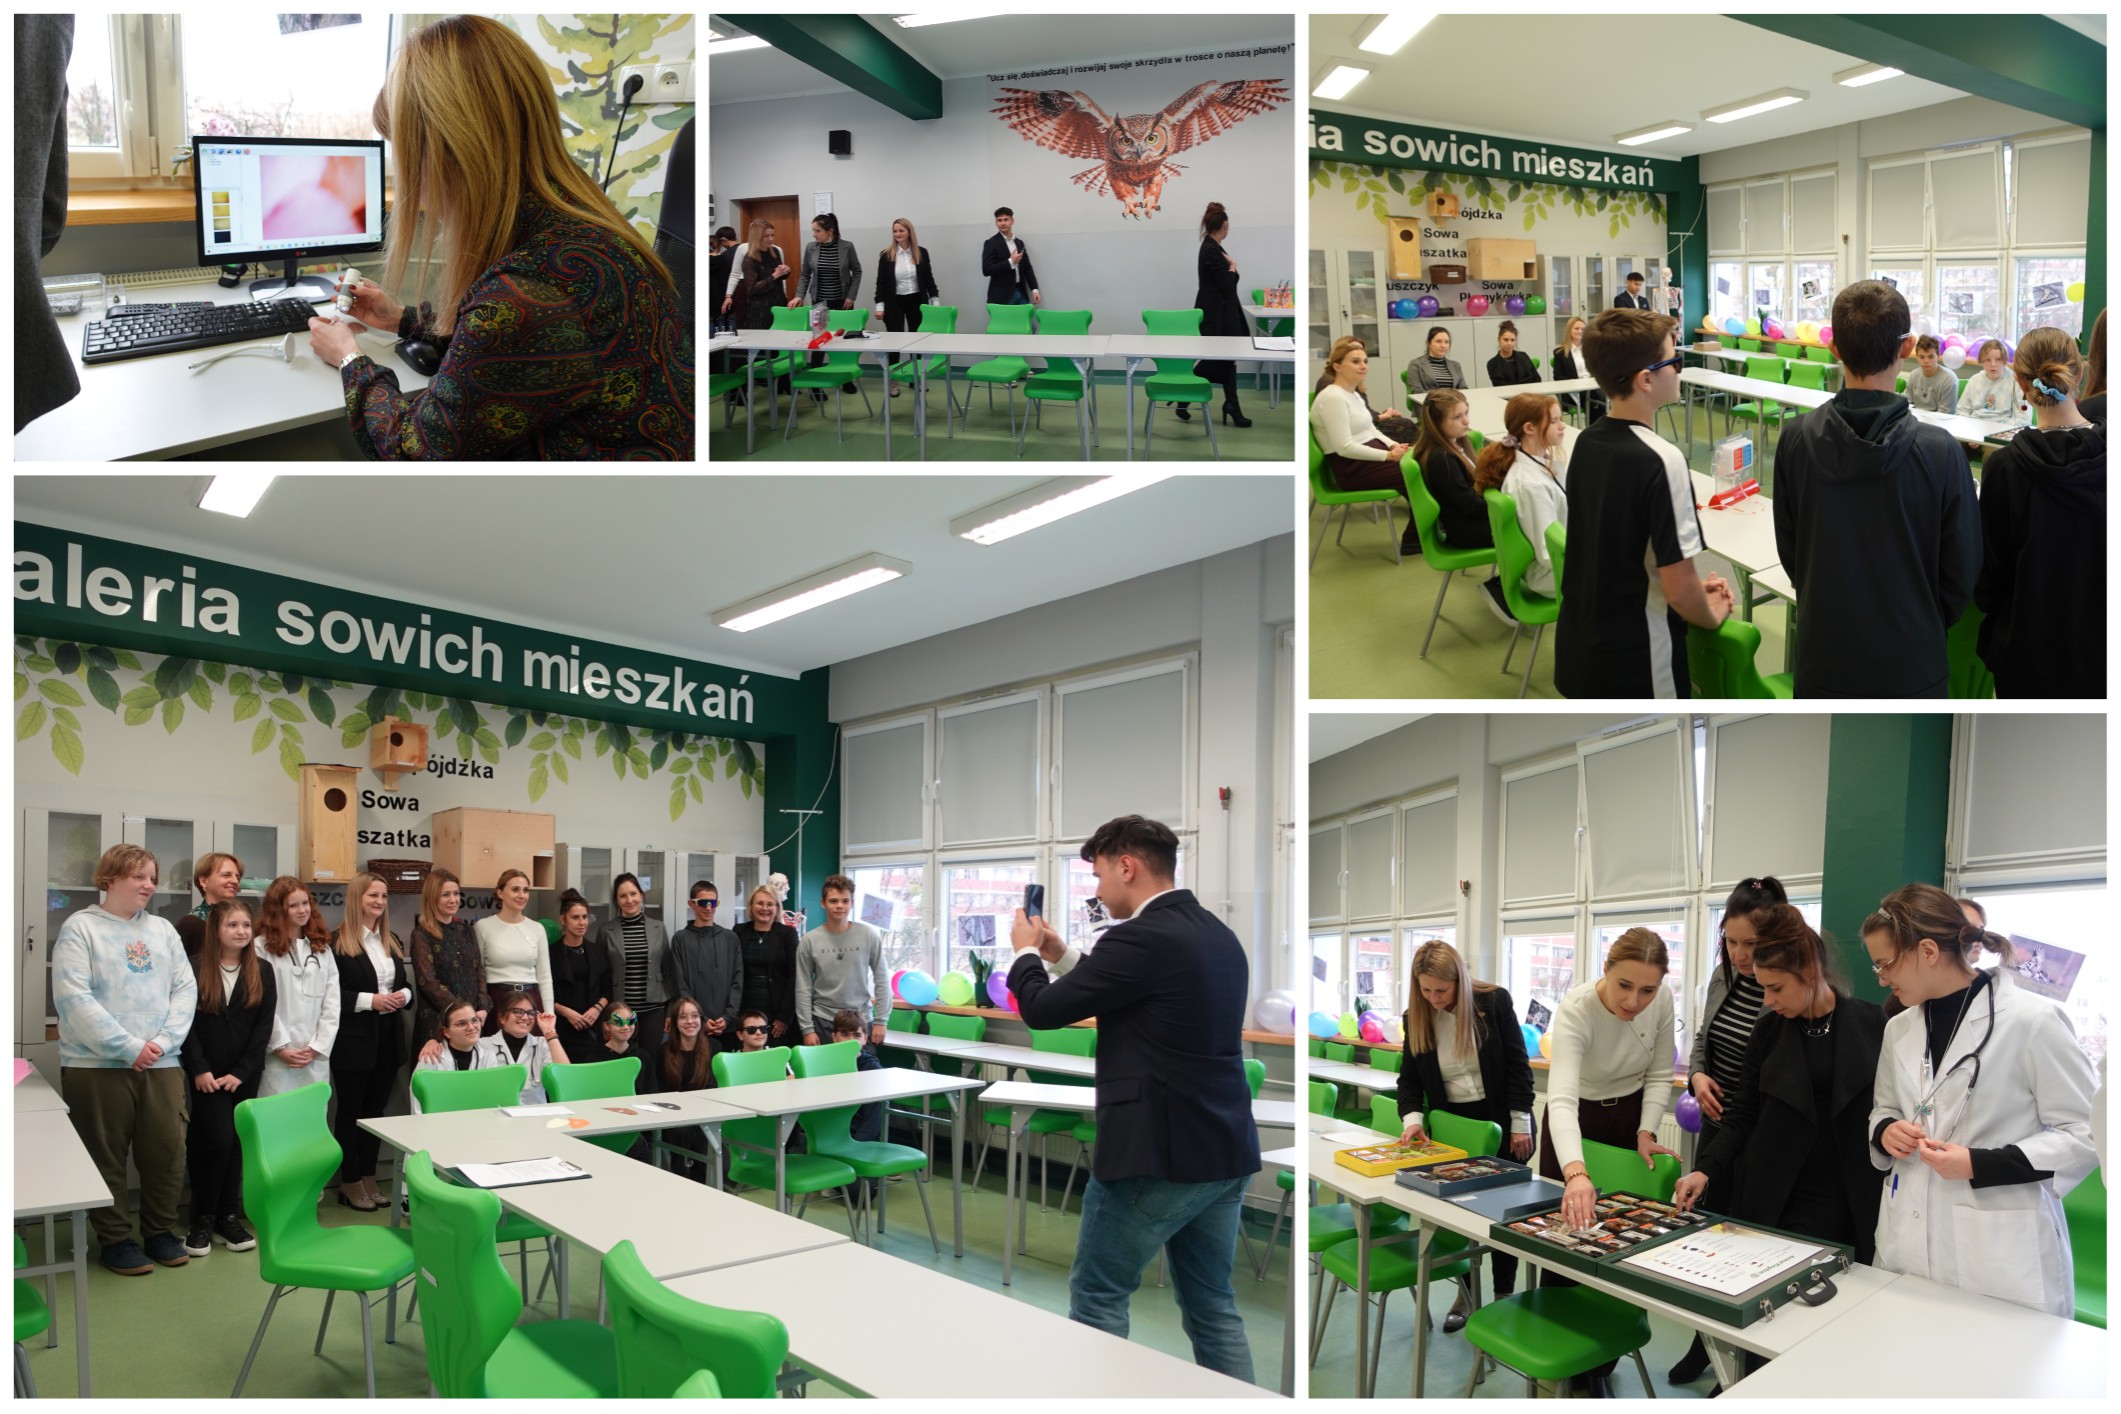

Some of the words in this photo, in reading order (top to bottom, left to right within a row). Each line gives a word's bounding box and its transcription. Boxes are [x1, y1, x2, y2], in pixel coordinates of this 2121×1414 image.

[1021, 66, 1069, 79] doświadczaj
[1074, 62, 1107, 74] rozwijaj
[1109, 60, 1132, 71] swoje
[1135, 55, 1173, 67] skrzydła
[1185, 52, 1214, 62] trosce
[1224, 50, 1251, 59] naszą
[1363, 128, 1502, 171] sowich
[1512, 147, 1655, 187] mieszkań
[1458, 207, 1502, 220] ójdźka
[1423, 227, 1459, 239] Sowa
[1482, 280, 1514, 290] Sowa
[13, 542, 241, 637] aleria
[275, 600, 503, 683] sowich
[523, 644, 755, 724] mieszkań
[426, 754, 494, 779] ójdźka
[361, 789, 420, 812] Sowa
